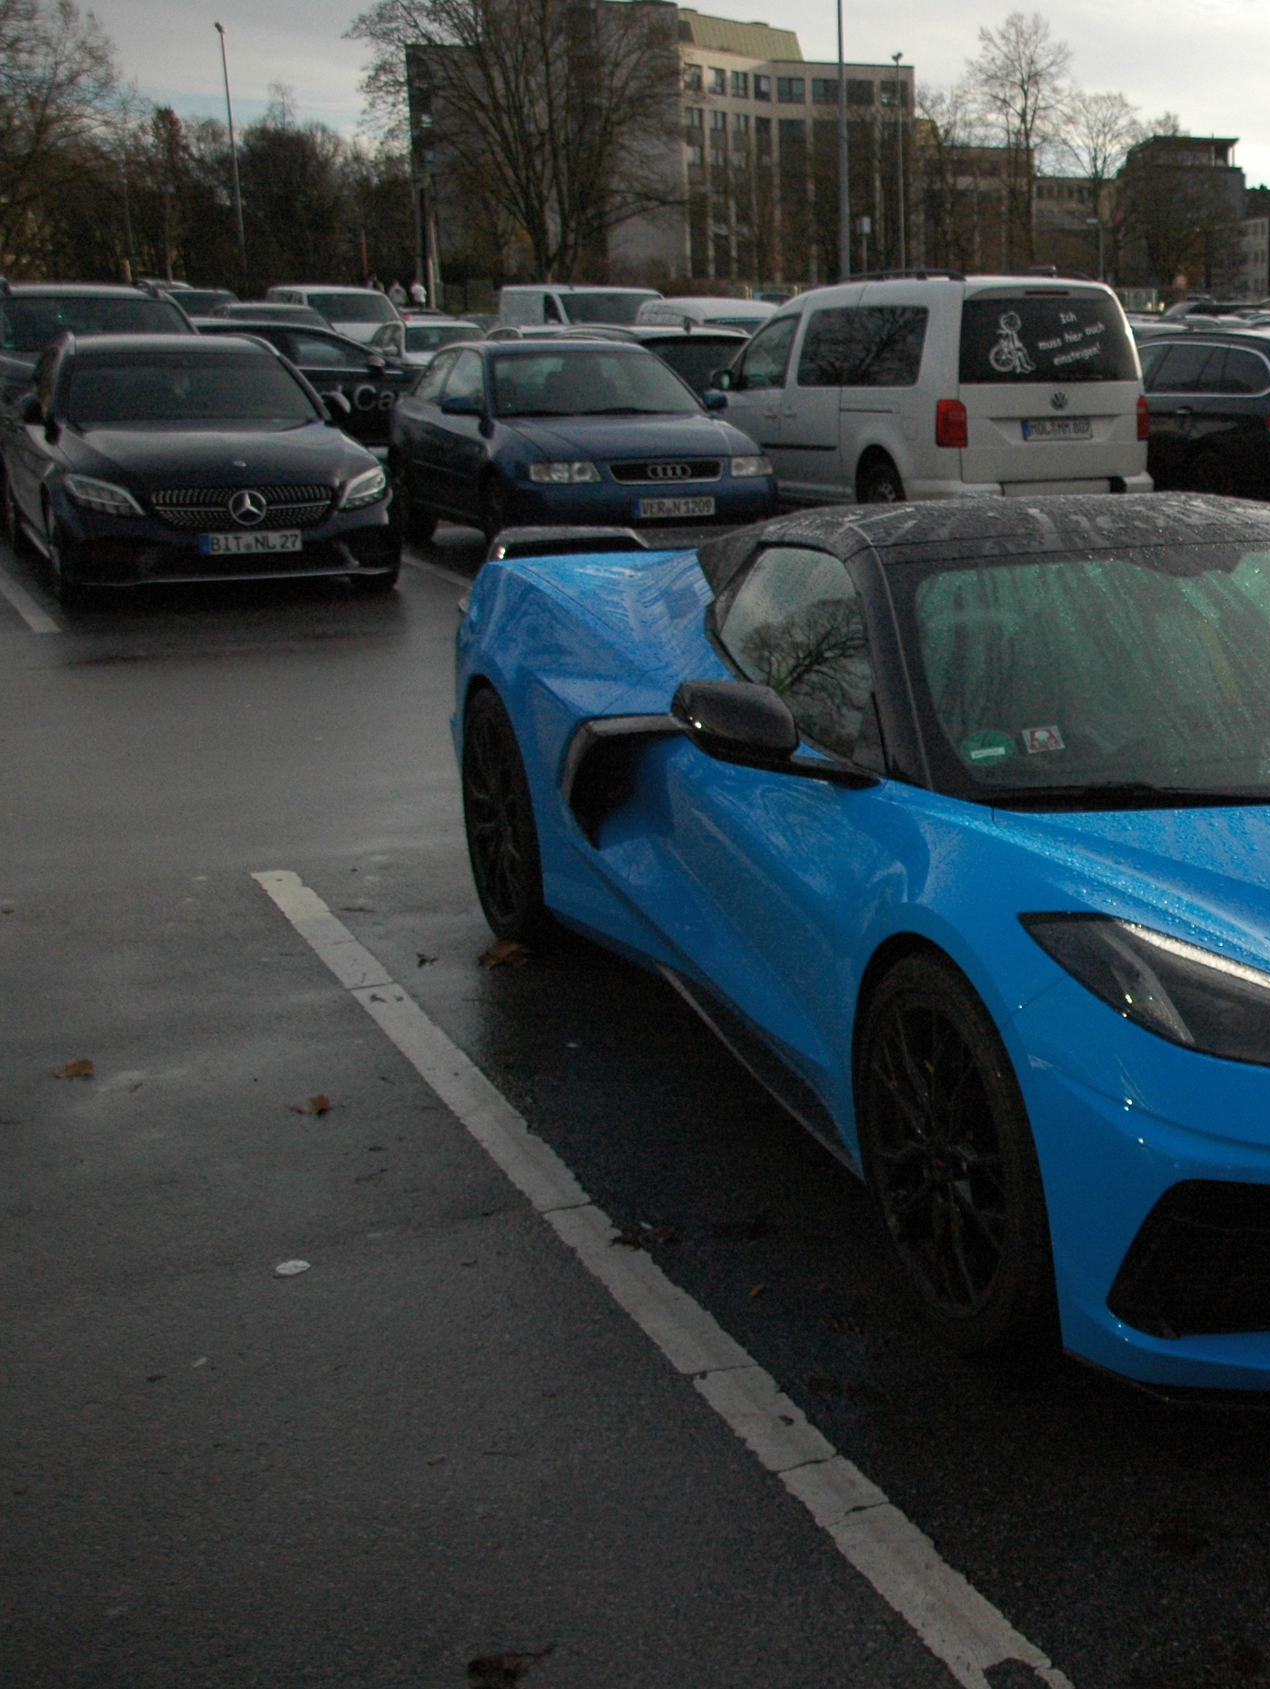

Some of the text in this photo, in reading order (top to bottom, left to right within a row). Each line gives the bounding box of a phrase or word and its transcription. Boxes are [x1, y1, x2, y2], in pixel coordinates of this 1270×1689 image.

[1059, 311, 1077, 324] Ich
[1038, 321, 1105, 350] muss hier auch
[354, 384, 397, 411] Ca
[641, 501, 667, 516] VER
[684, 499, 713, 514] 1209
[210, 534, 299, 552] BIT NL 27
